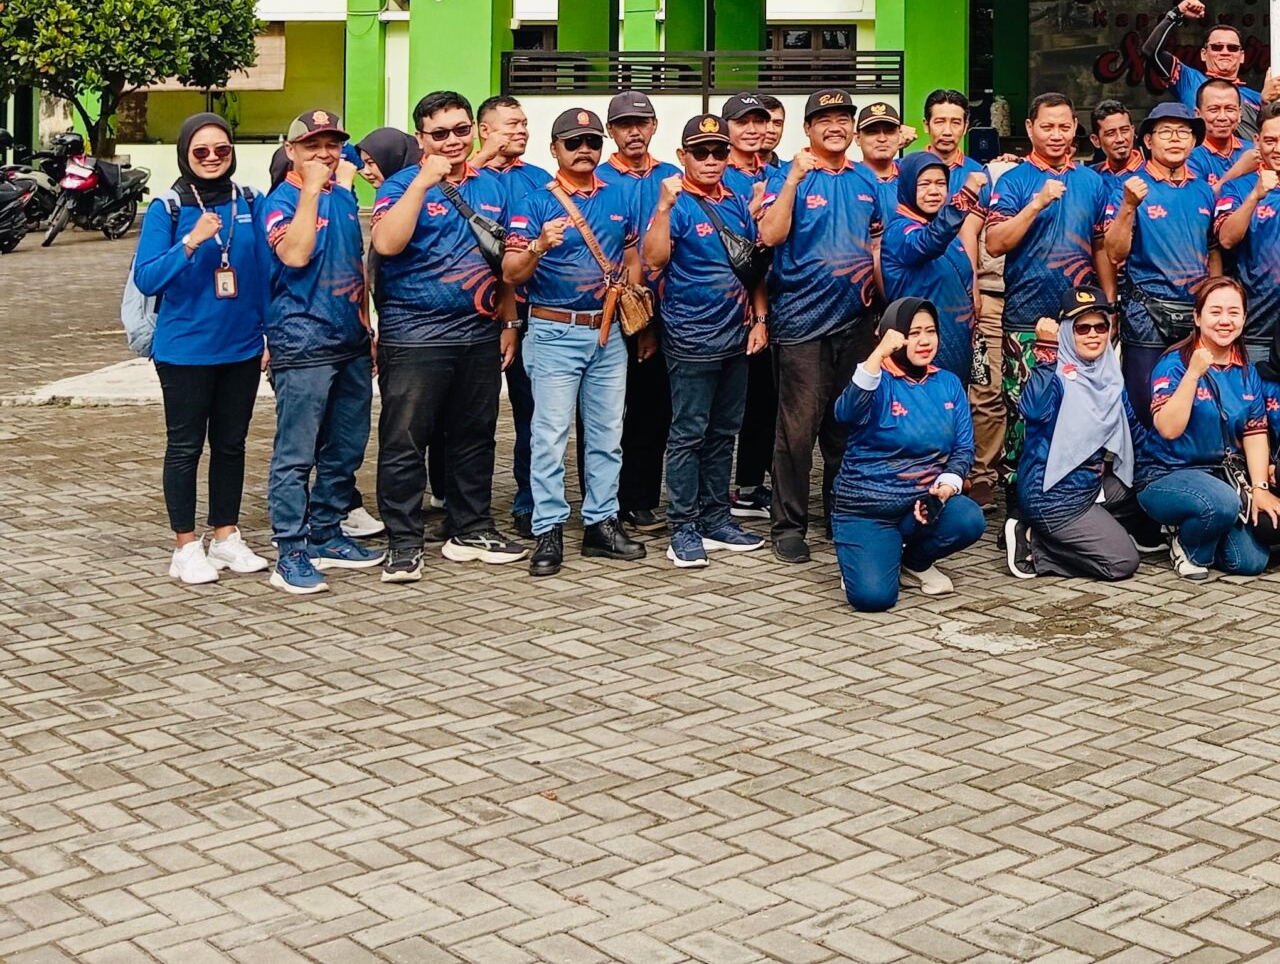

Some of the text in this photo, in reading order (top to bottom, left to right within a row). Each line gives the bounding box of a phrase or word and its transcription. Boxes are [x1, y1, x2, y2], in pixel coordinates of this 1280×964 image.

[819, 93, 844, 106] Bali
[806, 194, 828, 209] 54
[426, 202, 448, 217] 54
[1147, 205, 1168, 219] 54
[1256, 205, 1276, 219] 54
[695, 222, 714, 237] 54
